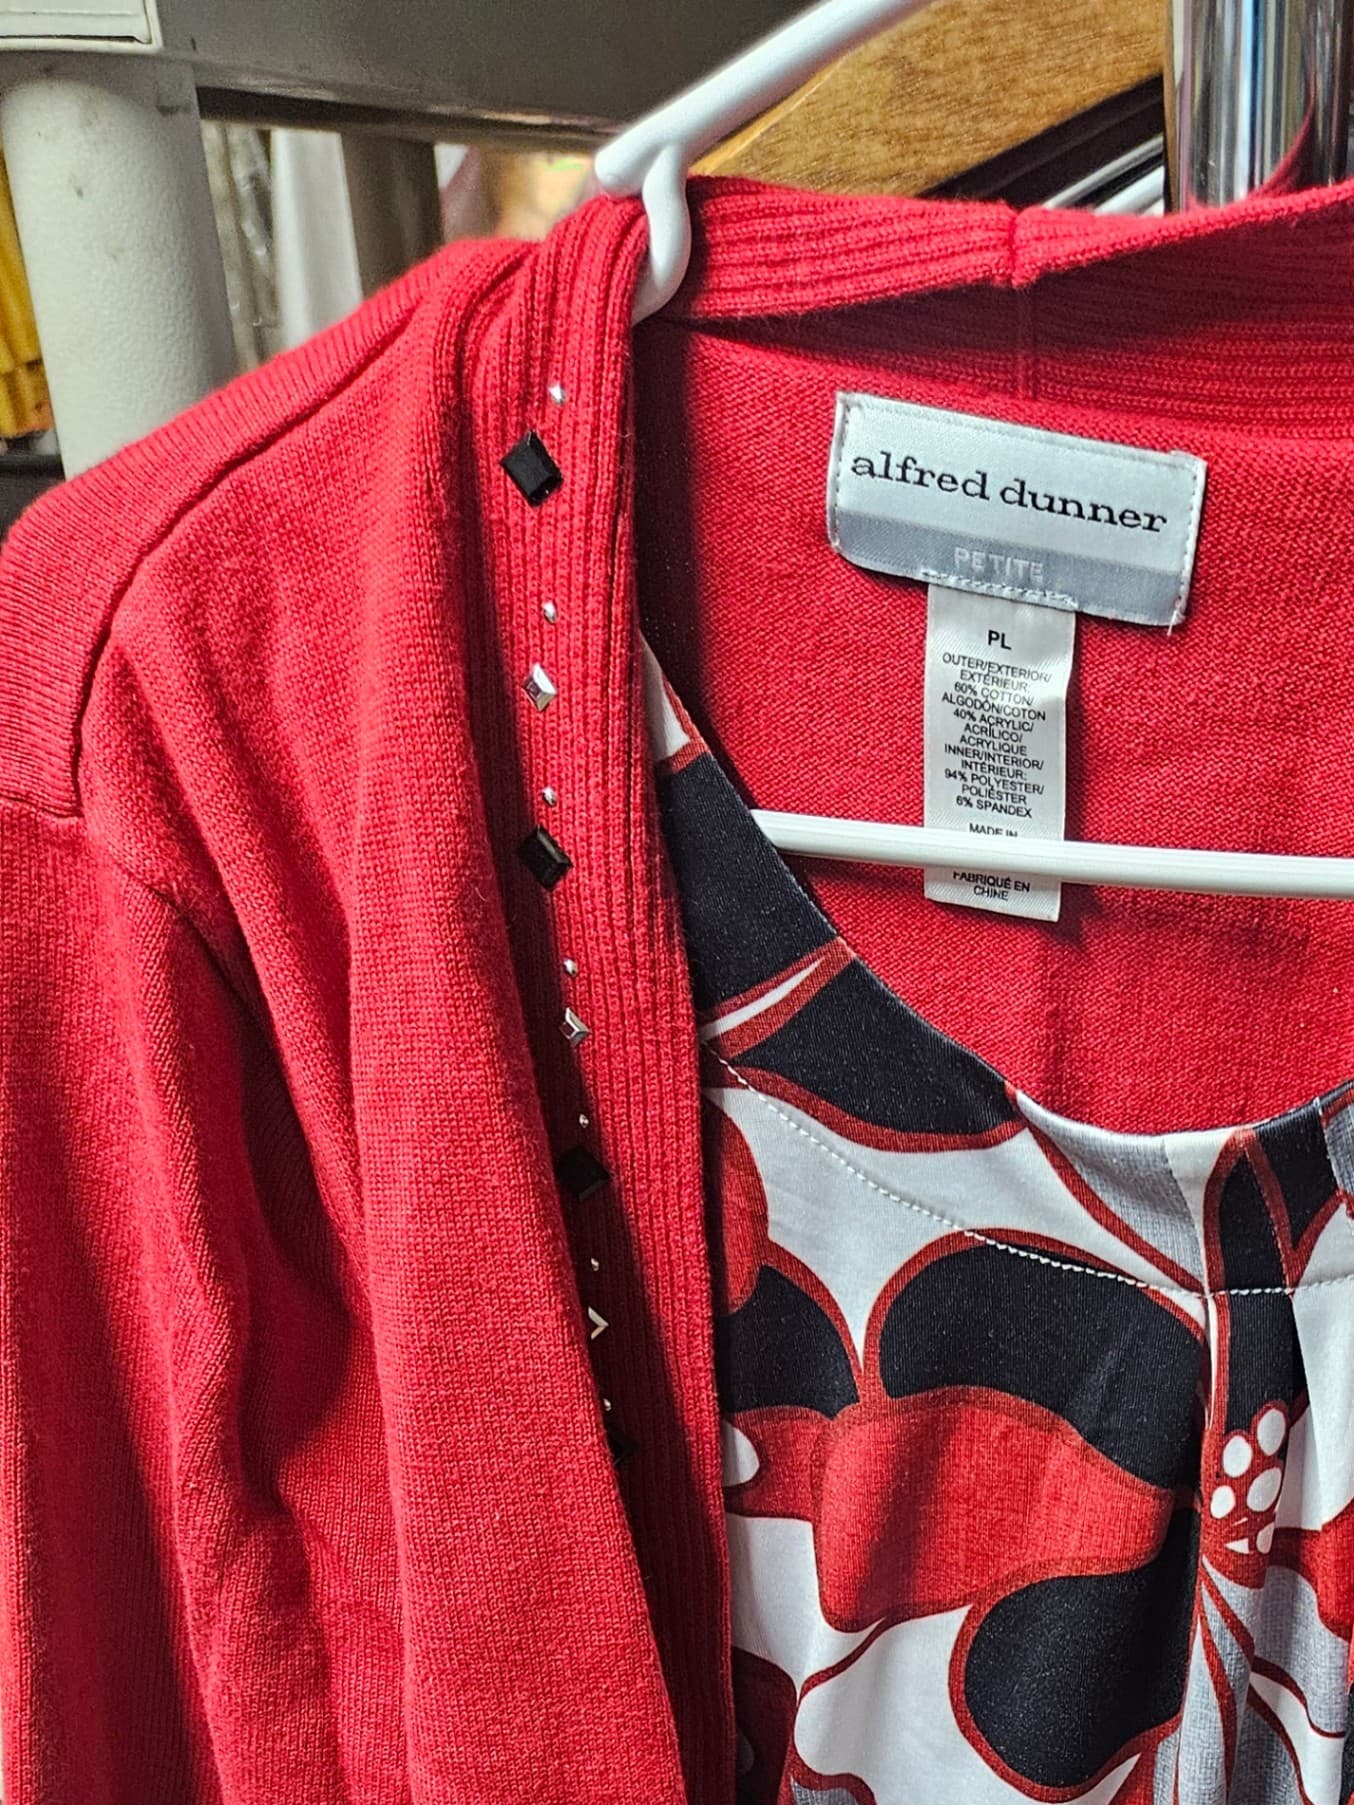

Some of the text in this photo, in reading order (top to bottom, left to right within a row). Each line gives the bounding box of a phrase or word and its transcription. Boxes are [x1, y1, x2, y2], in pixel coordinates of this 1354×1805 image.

[850, 451, 1168, 533] alfred dunner
[954, 546, 1045, 584] PETITE
[987, 629, 1012, 650] PL
[954, 681, 978, 697] 60%
[953, 708, 1034, 733] 40% ACRYLIC/
[944, 743, 1044, 770] INNER/INTERIOR/
[960, 735, 1027, 757] ACRYLIQUE
[944, 768, 1045, 795] 94% POLYESTER/
[961, 784, 1027, 805] POLIÉSTER
[956, 795, 1032, 819] 6% SPANDEX
[952, 871, 1030, 893] FABRIQUÉ EN
[973, 885, 1009, 901] CHINE
